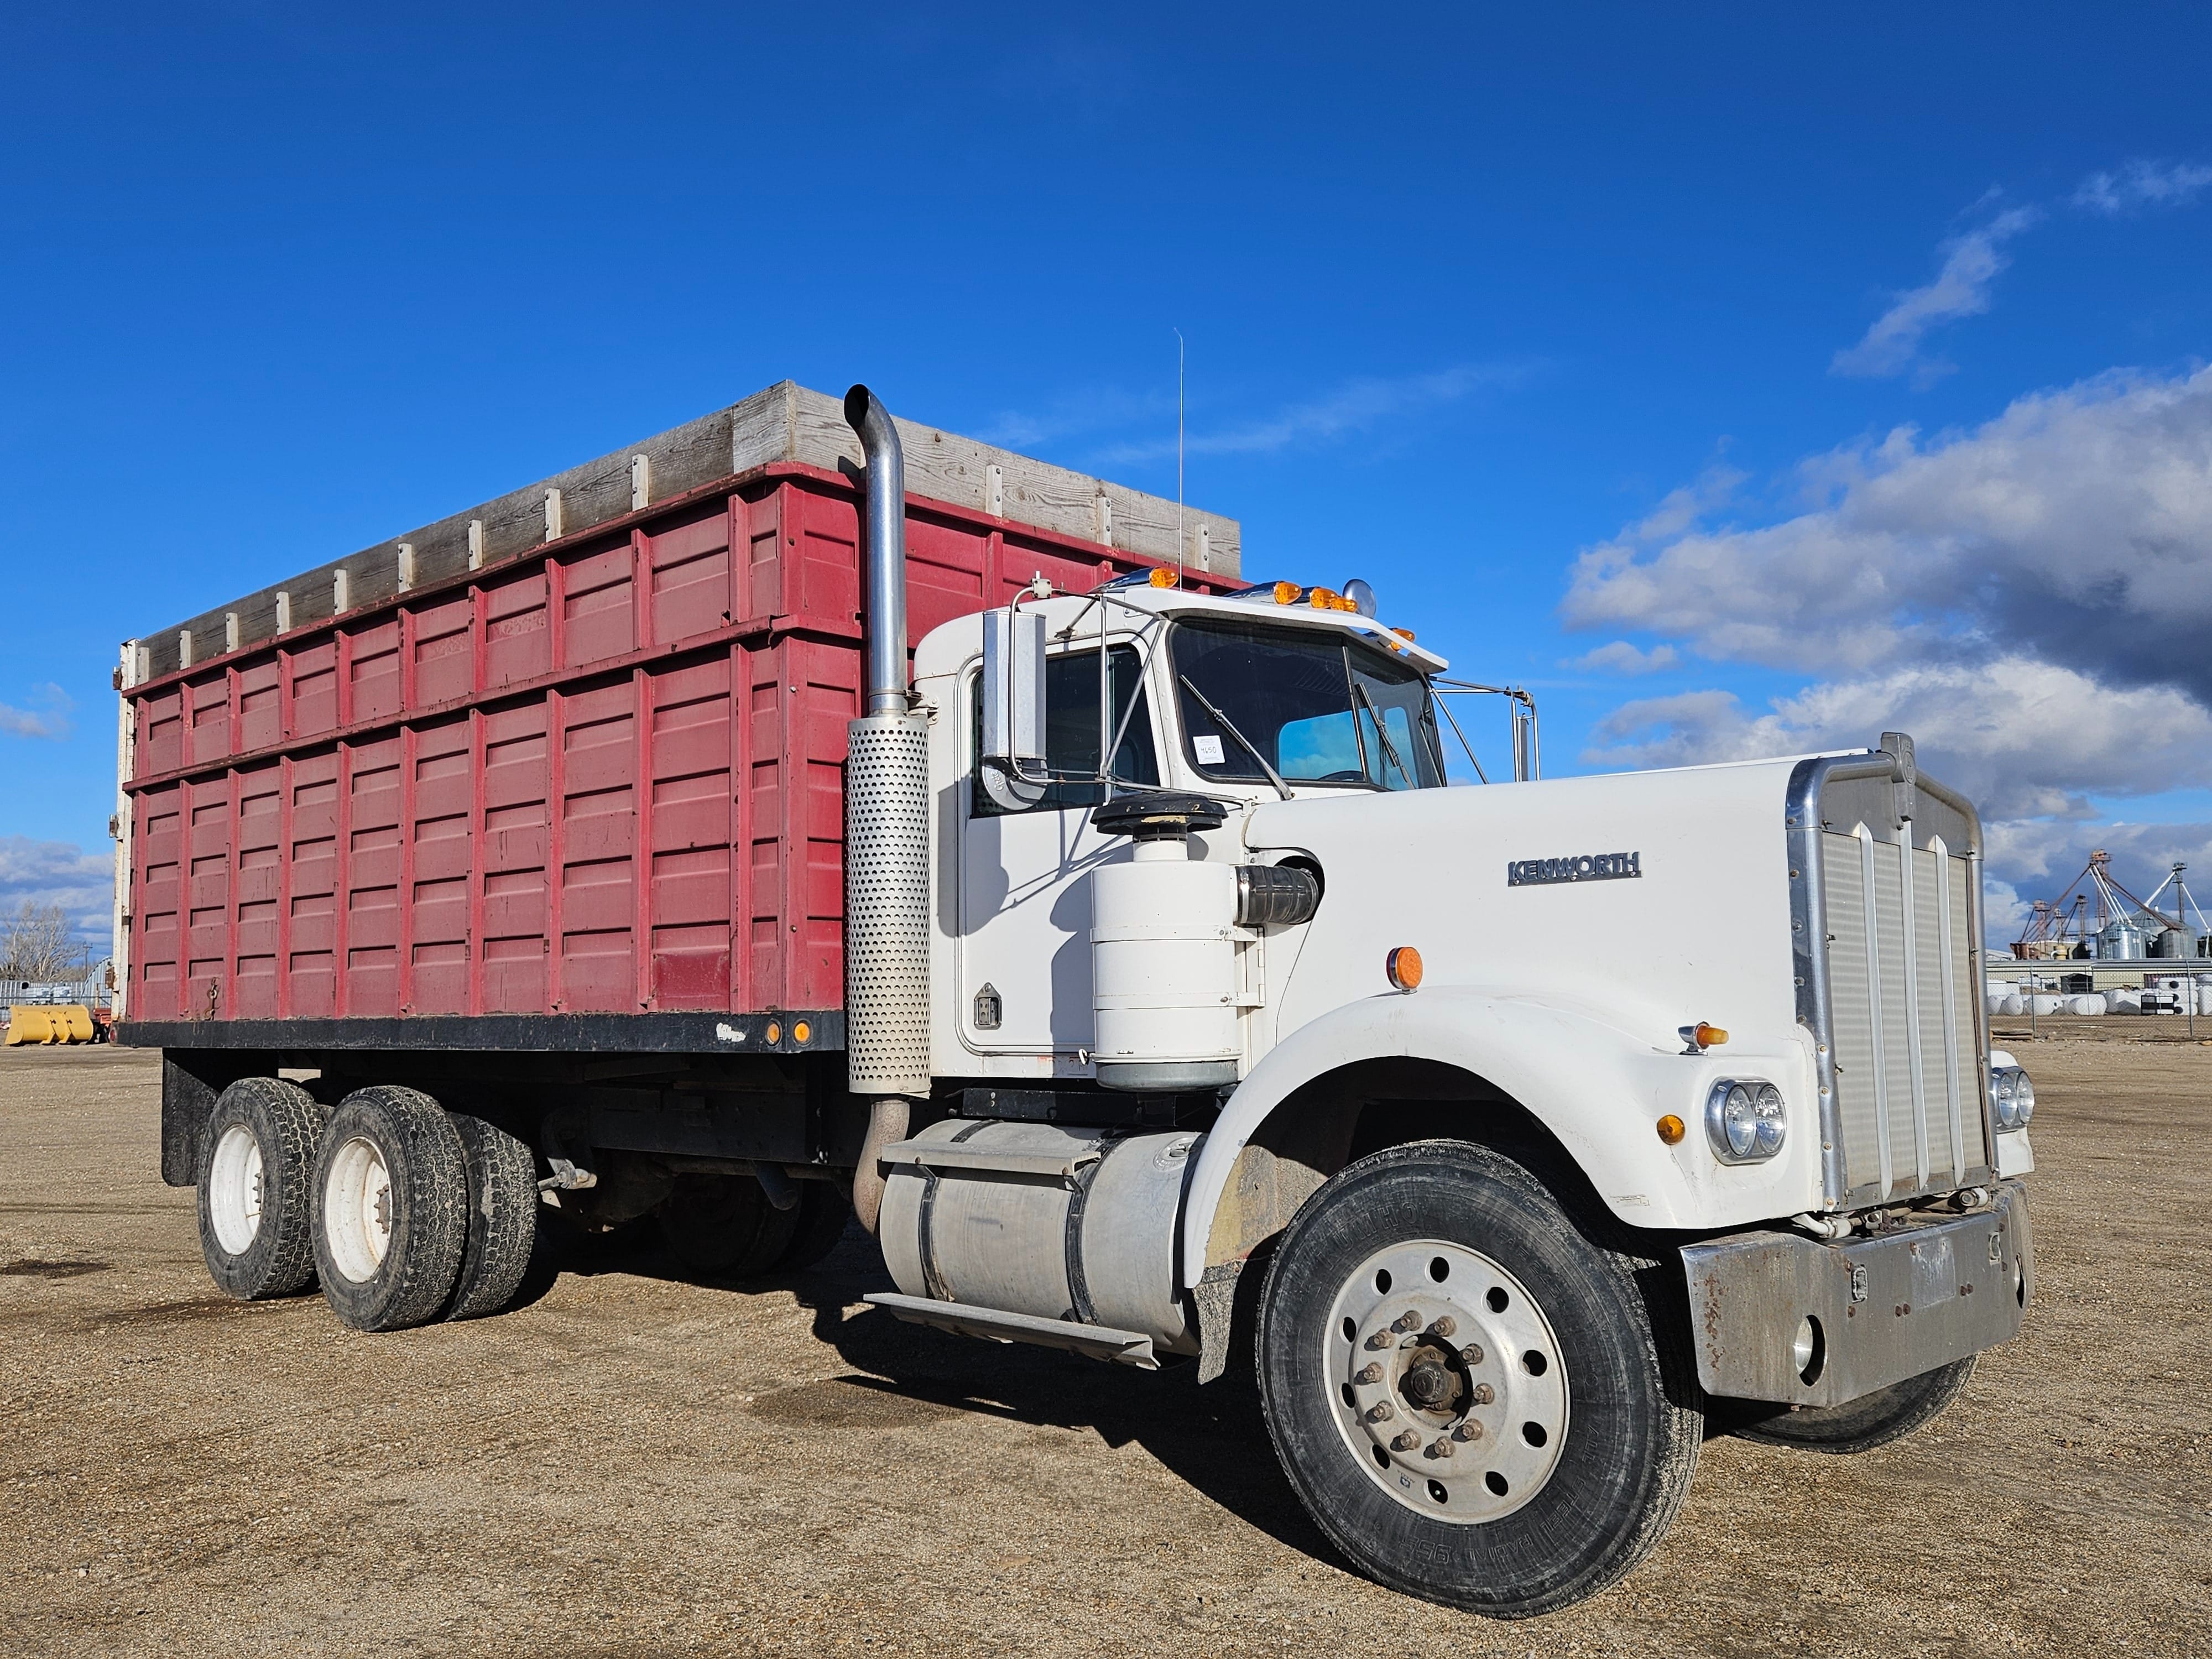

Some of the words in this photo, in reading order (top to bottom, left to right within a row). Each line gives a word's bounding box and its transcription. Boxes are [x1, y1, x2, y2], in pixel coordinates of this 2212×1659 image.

[1508, 852, 1640, 881] KENWORTH
[1582, 1424, 1599, 1463] ALL
[1540, 1477, 1586, 1532] STEEL
[1464, 1533, 1533, 1561] RADIAL
